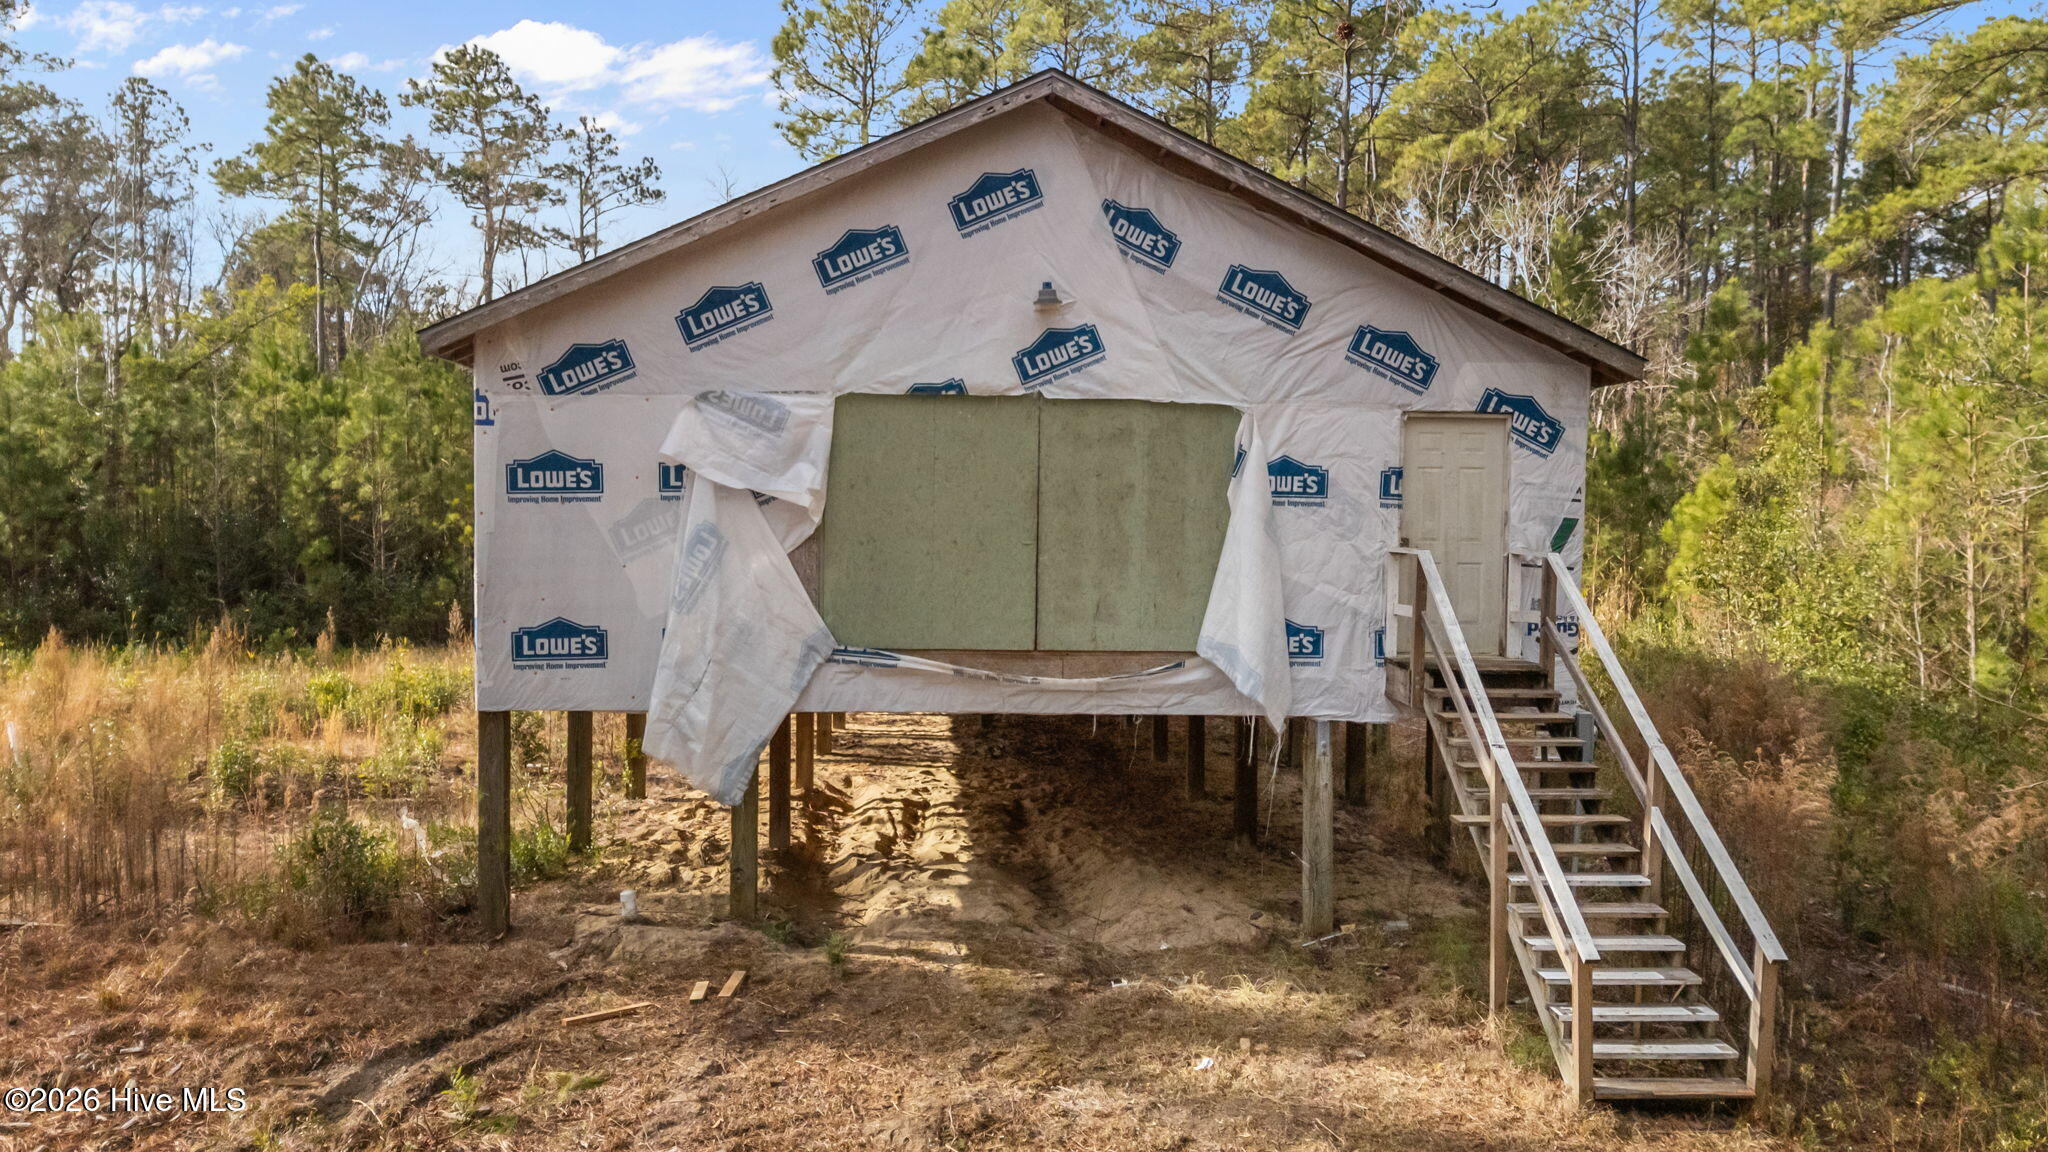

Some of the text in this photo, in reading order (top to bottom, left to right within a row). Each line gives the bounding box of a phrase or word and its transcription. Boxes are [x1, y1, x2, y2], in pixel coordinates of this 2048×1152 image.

[959, 181, 1030, 222] LOWE'S
[990, 216, 1007, 228] Home
[824, 237, 896, 278] LOWE'S
[855, 273, 872, 284] Home
[1231, 272, 1299, 319] LOWE'S
[687, 294, 760, 336] LOWE'S
[1244, 307, 1260, 319] Home
[719, 329, 736, 341] Home
[1022, 335, 1093, 376] LOWE'S
[1360, 332, 1426, 380] LOWE'S
[548, 351, 623, 393] LOWE'S
[1053, 370, 1070, 381] Home
[1372, 366, 1389, 380] Home
[517, 467, 593, 488] LOWE'S
[541, 495, 560, 503] Home
[1527, 622, 1579, 637] Gud
[522, 633, 597, 655] LOWE'S
[546, 662, 563, 670] Home
